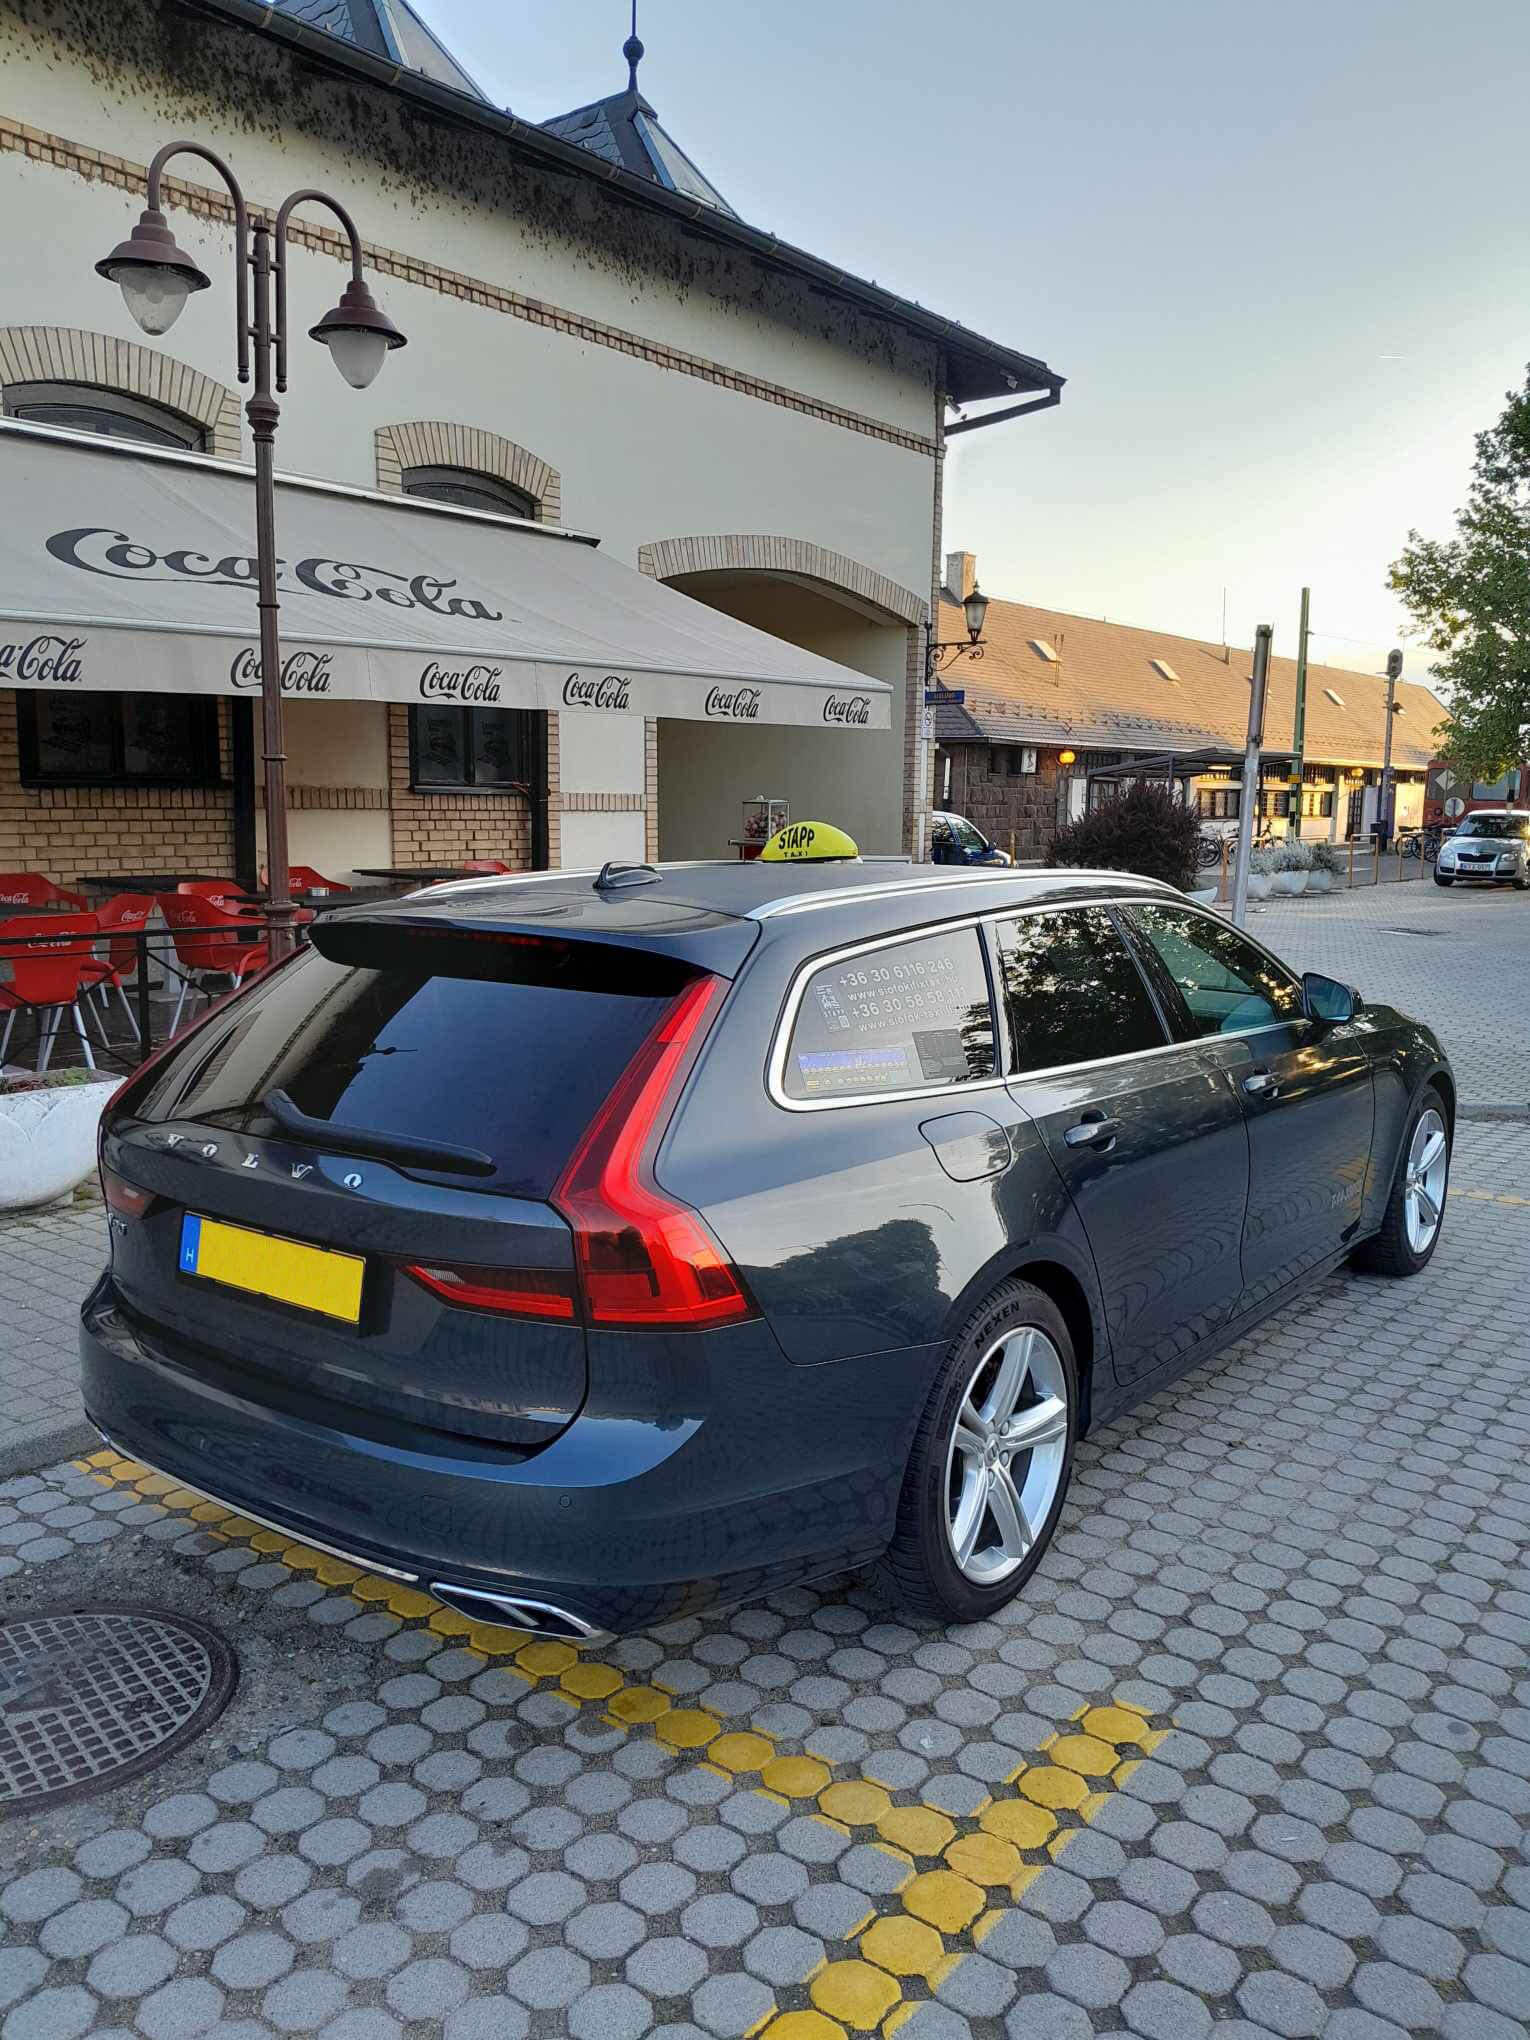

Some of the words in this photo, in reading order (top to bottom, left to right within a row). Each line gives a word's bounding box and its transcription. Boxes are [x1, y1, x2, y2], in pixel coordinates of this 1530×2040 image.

[420, 662, 502, 702] Coca-Cola
[563, 673, 632, 709] Coca-Cola
[705, 686, 761, 718] Coca-Cola
[823, 695, 871, 724] Coca-Cola
[779, 826, 815, 849] STAPP
[784, 850, 808, 858] TAXI
[840, 971, 868, 986] +36
[870, 967, 890, 982] 30
[893, 962, 925, 979] 6116
[928, 958, 954, 973] 246
[852, 1002, 880, 1018] +36
[883, 998, 902, 1013] 30
[905, 993, 925, 1009] 58
[926, 989, 945, 1005] 58
[168, 1133, 362, 1189] VOLVO
[974, 1301, 1020, 1349] NEXEN
